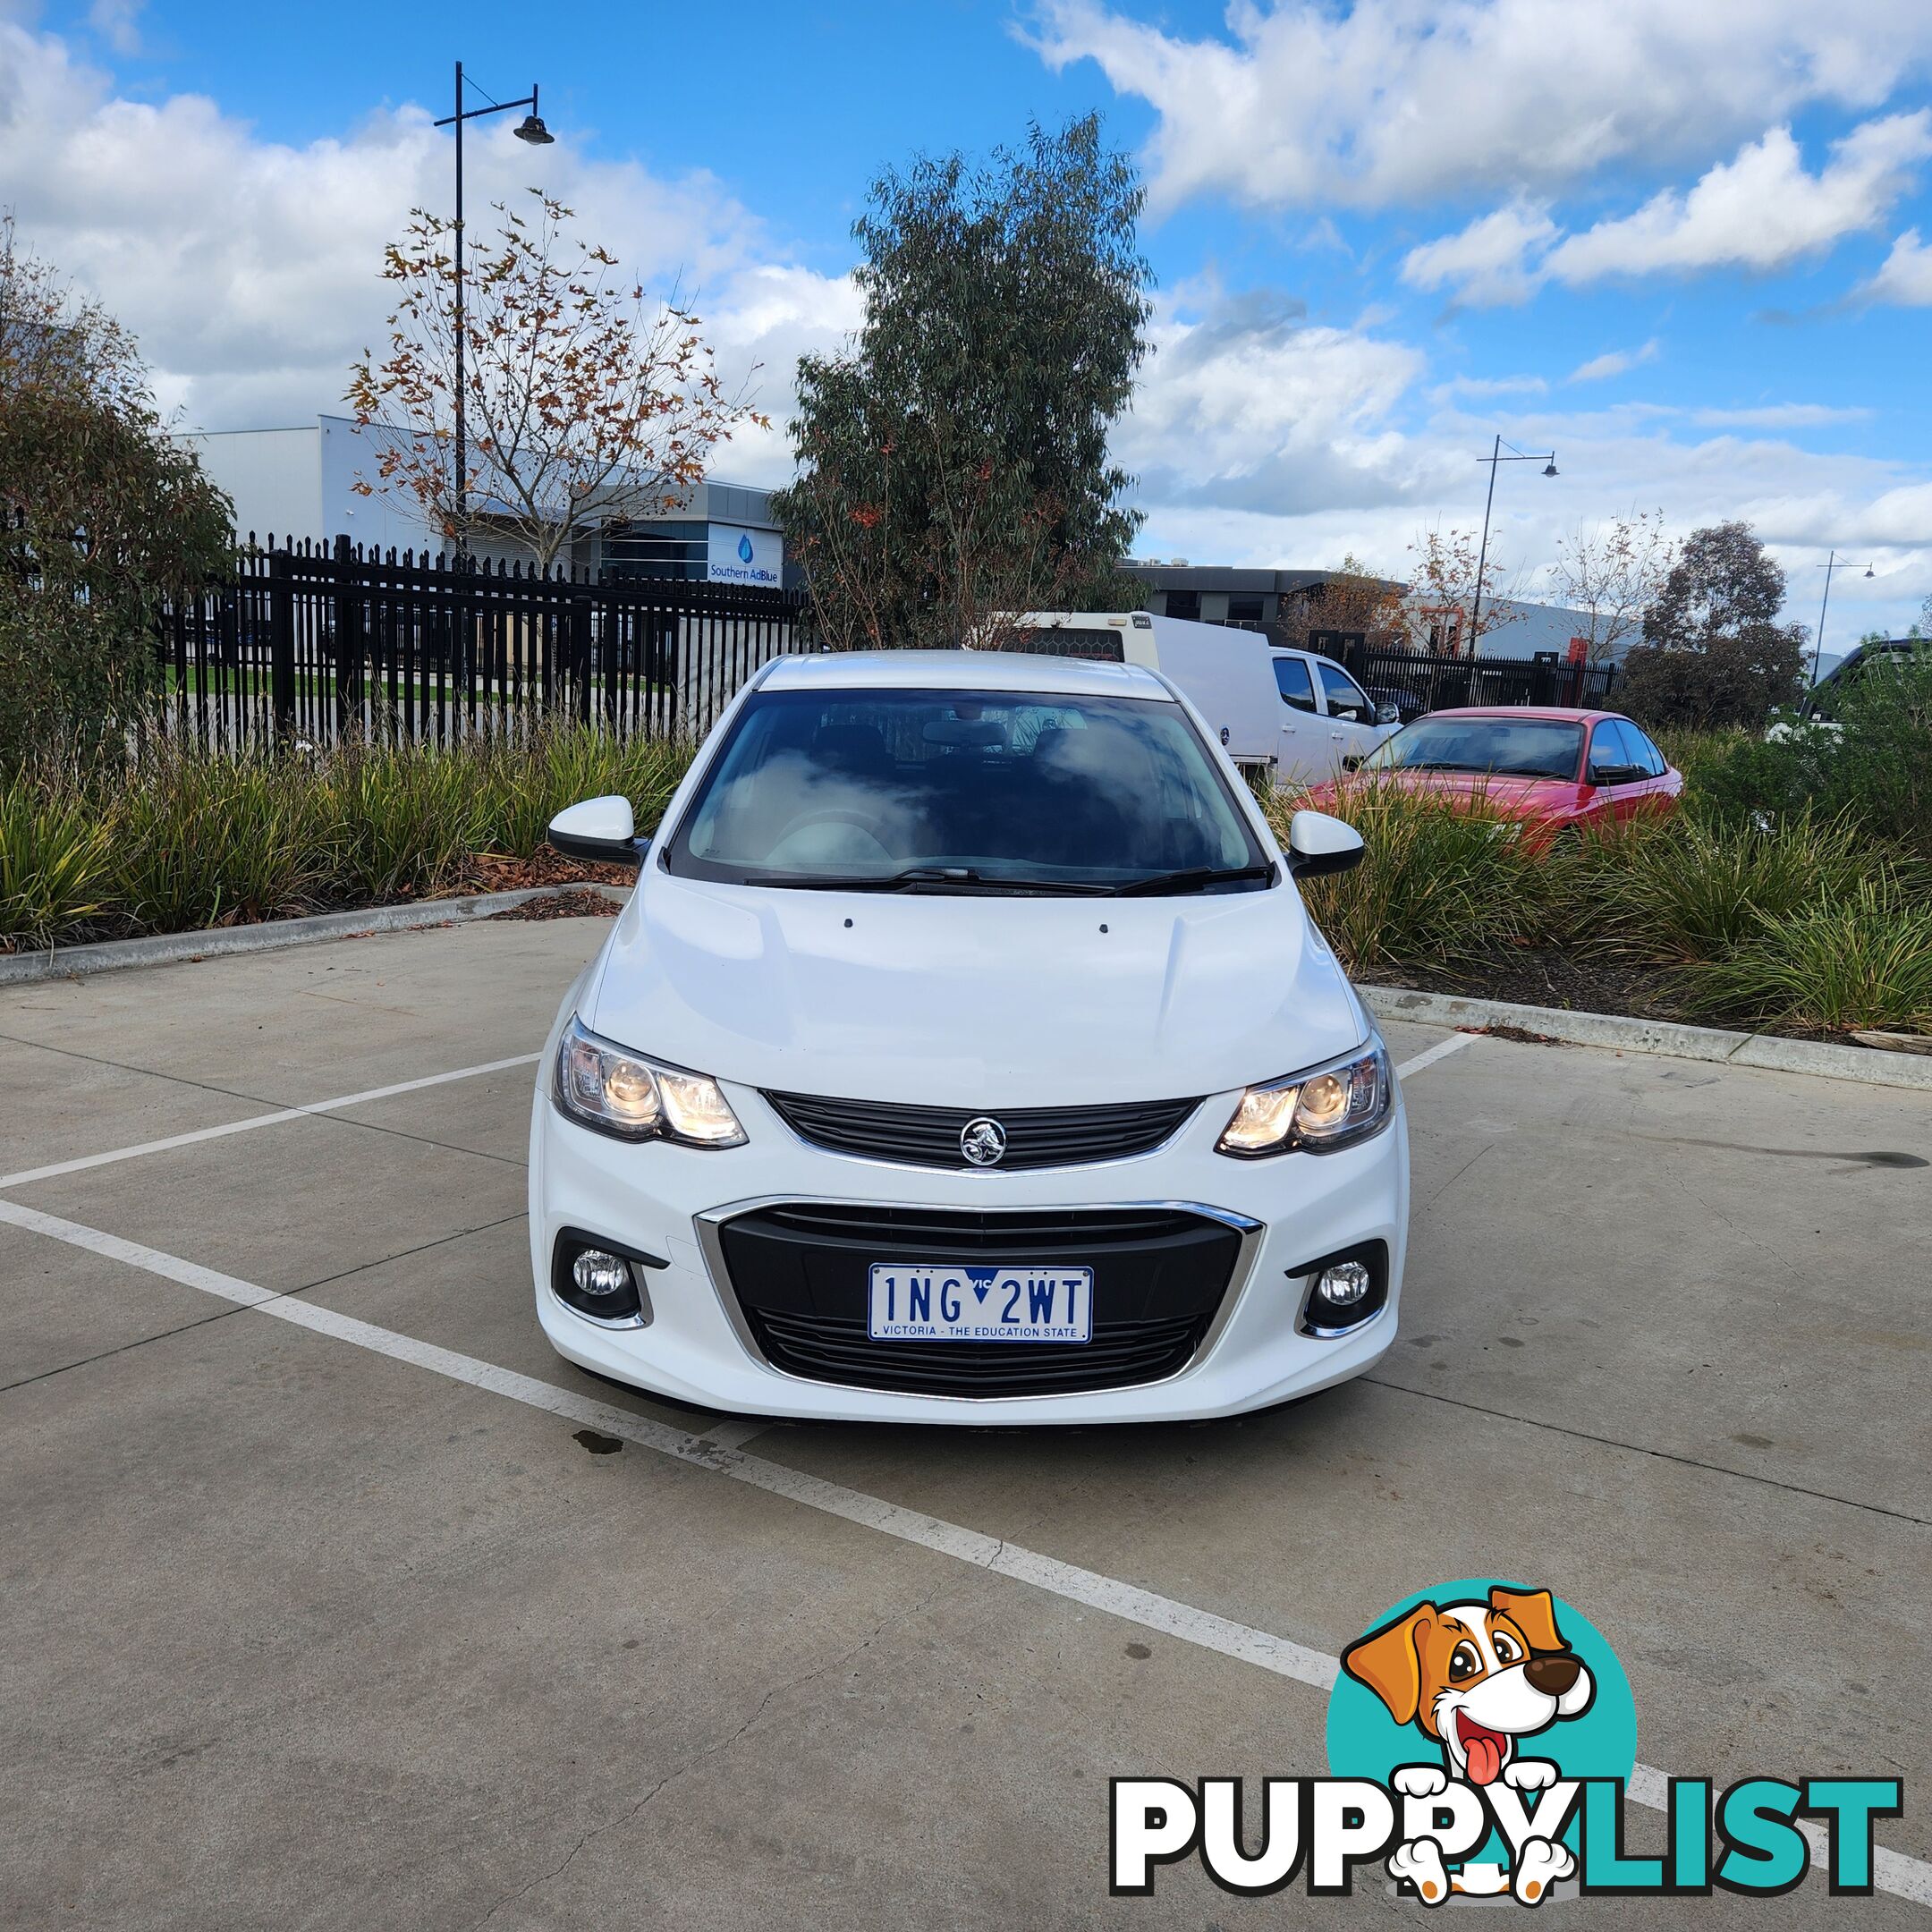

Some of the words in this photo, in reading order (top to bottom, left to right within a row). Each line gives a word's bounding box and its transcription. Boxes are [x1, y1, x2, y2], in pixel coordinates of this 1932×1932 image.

[711, 564, 749, 579] Southern
[750, 569, 778, 582] AdBlue
[970, 1278, 992, 1290] VIC
[885, 1276, 961, 1323] 1NG
[1001, 1279, 1082, 1324] 2WT
[883, 1325, 936, 1335] VICTORIA
[949, 1326, 970, 1336] THE
[975, 1327, 1040, 1337] EDUCATION
[1044, 1328, 1078, 1338] STATE
